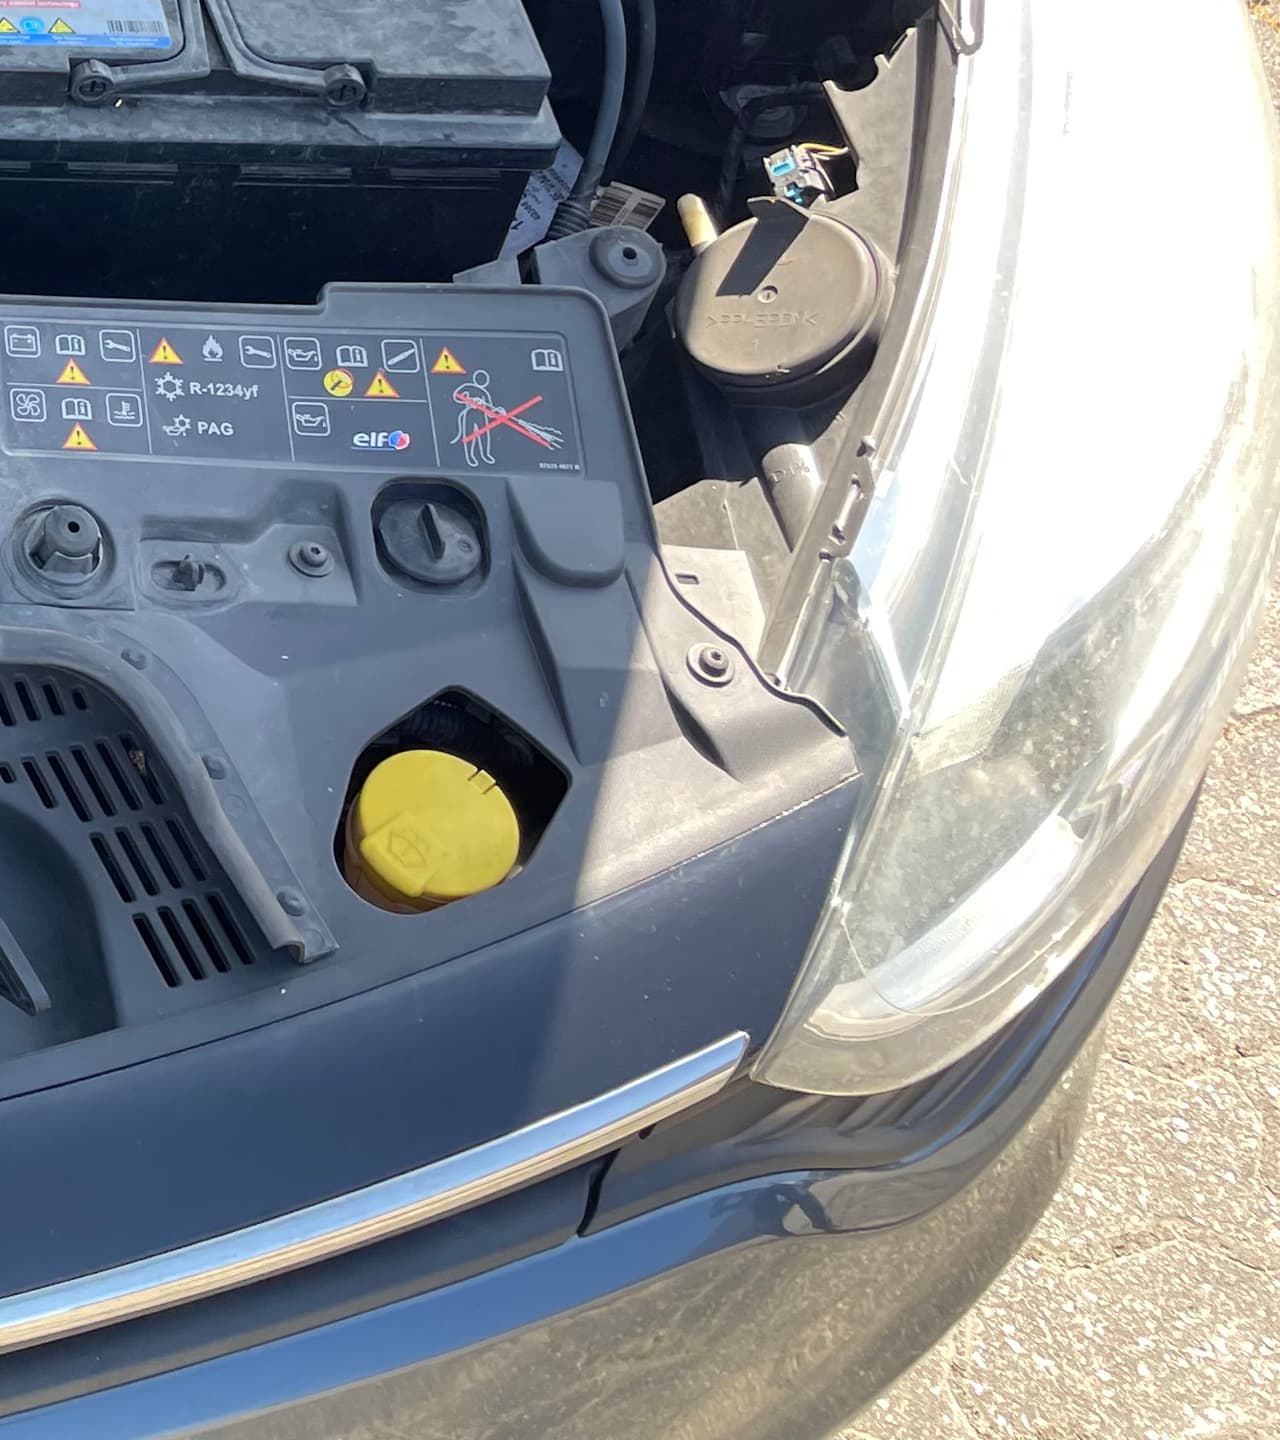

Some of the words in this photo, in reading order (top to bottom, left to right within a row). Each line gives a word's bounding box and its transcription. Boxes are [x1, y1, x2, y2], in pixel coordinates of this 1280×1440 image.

[189, 381, 259, 399] R-1234yf
[197, 421, 234, 436] PAG
[352, 432, 389, 448] elf
